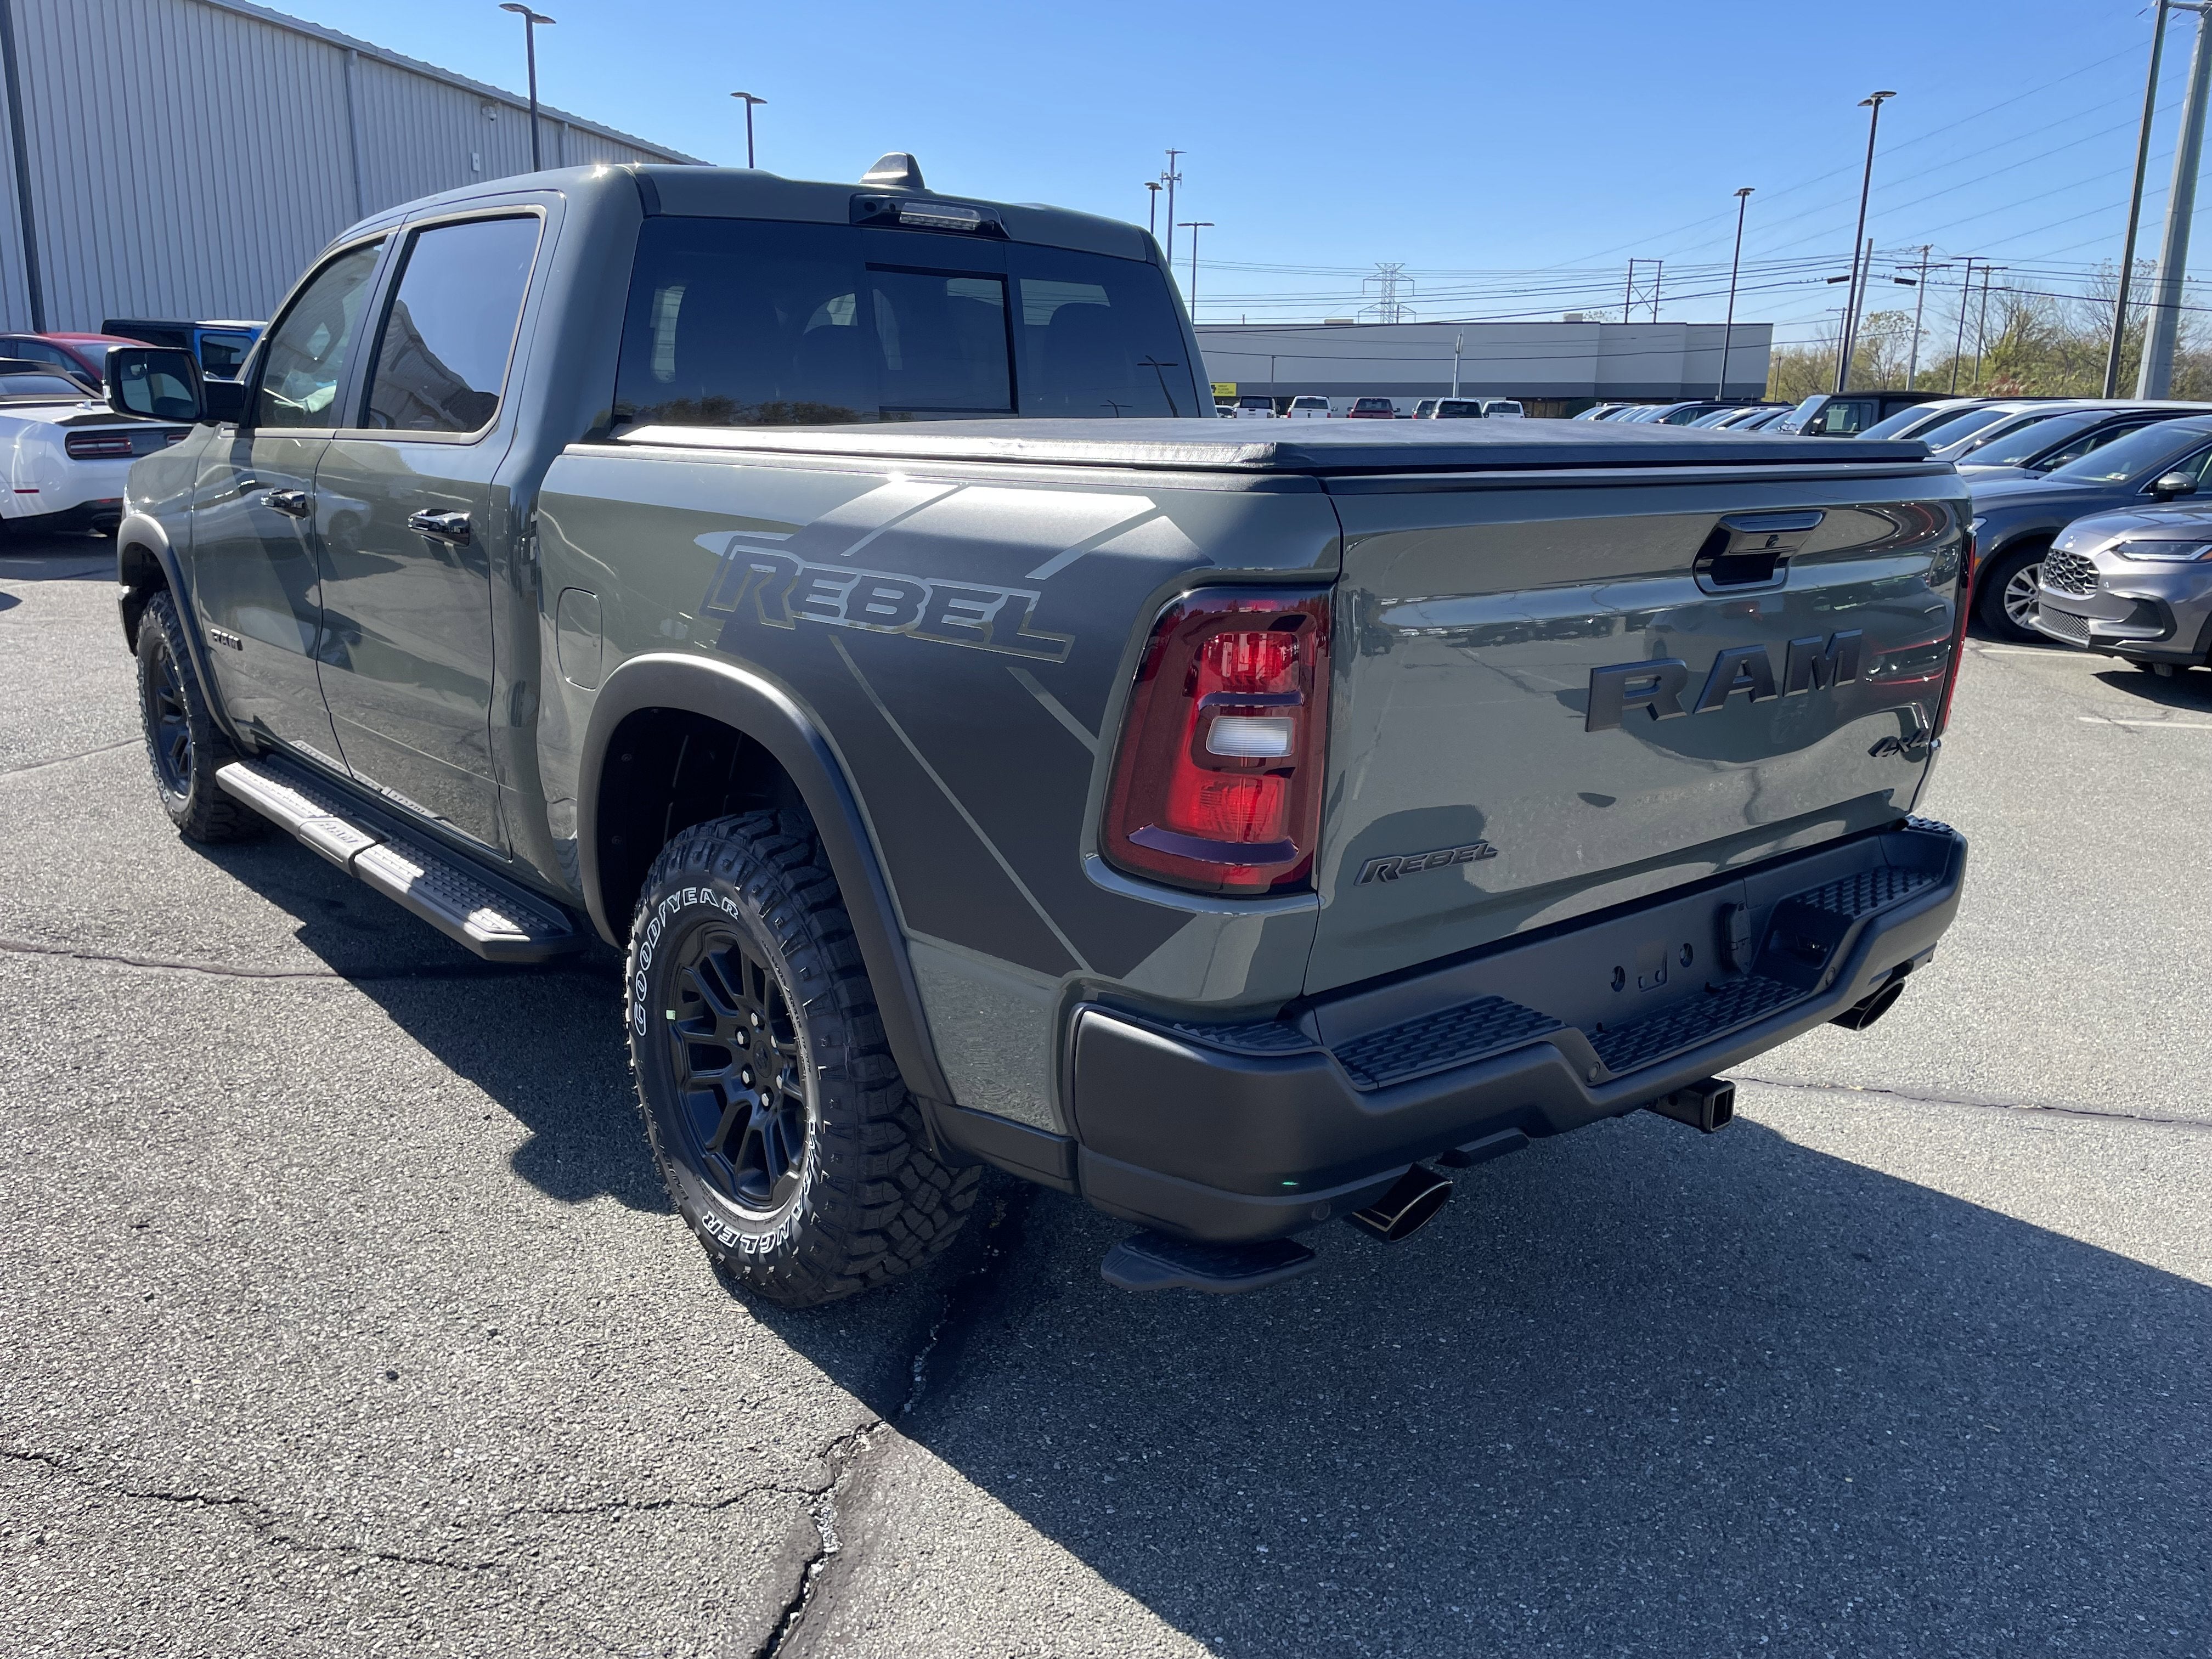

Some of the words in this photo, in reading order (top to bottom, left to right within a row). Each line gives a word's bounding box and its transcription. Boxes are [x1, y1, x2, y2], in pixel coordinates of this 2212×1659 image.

[210, 628, 243, 651] RAM
[705, 542, 1076, 663] REBEL
[1585, 629, 1863, 732] RAM
[1353, 840, 1498, 885] REBEL
[634, 887, 739, 1036] GOODYEAR
[702, 1119, 816, 1254] WRANGLER
